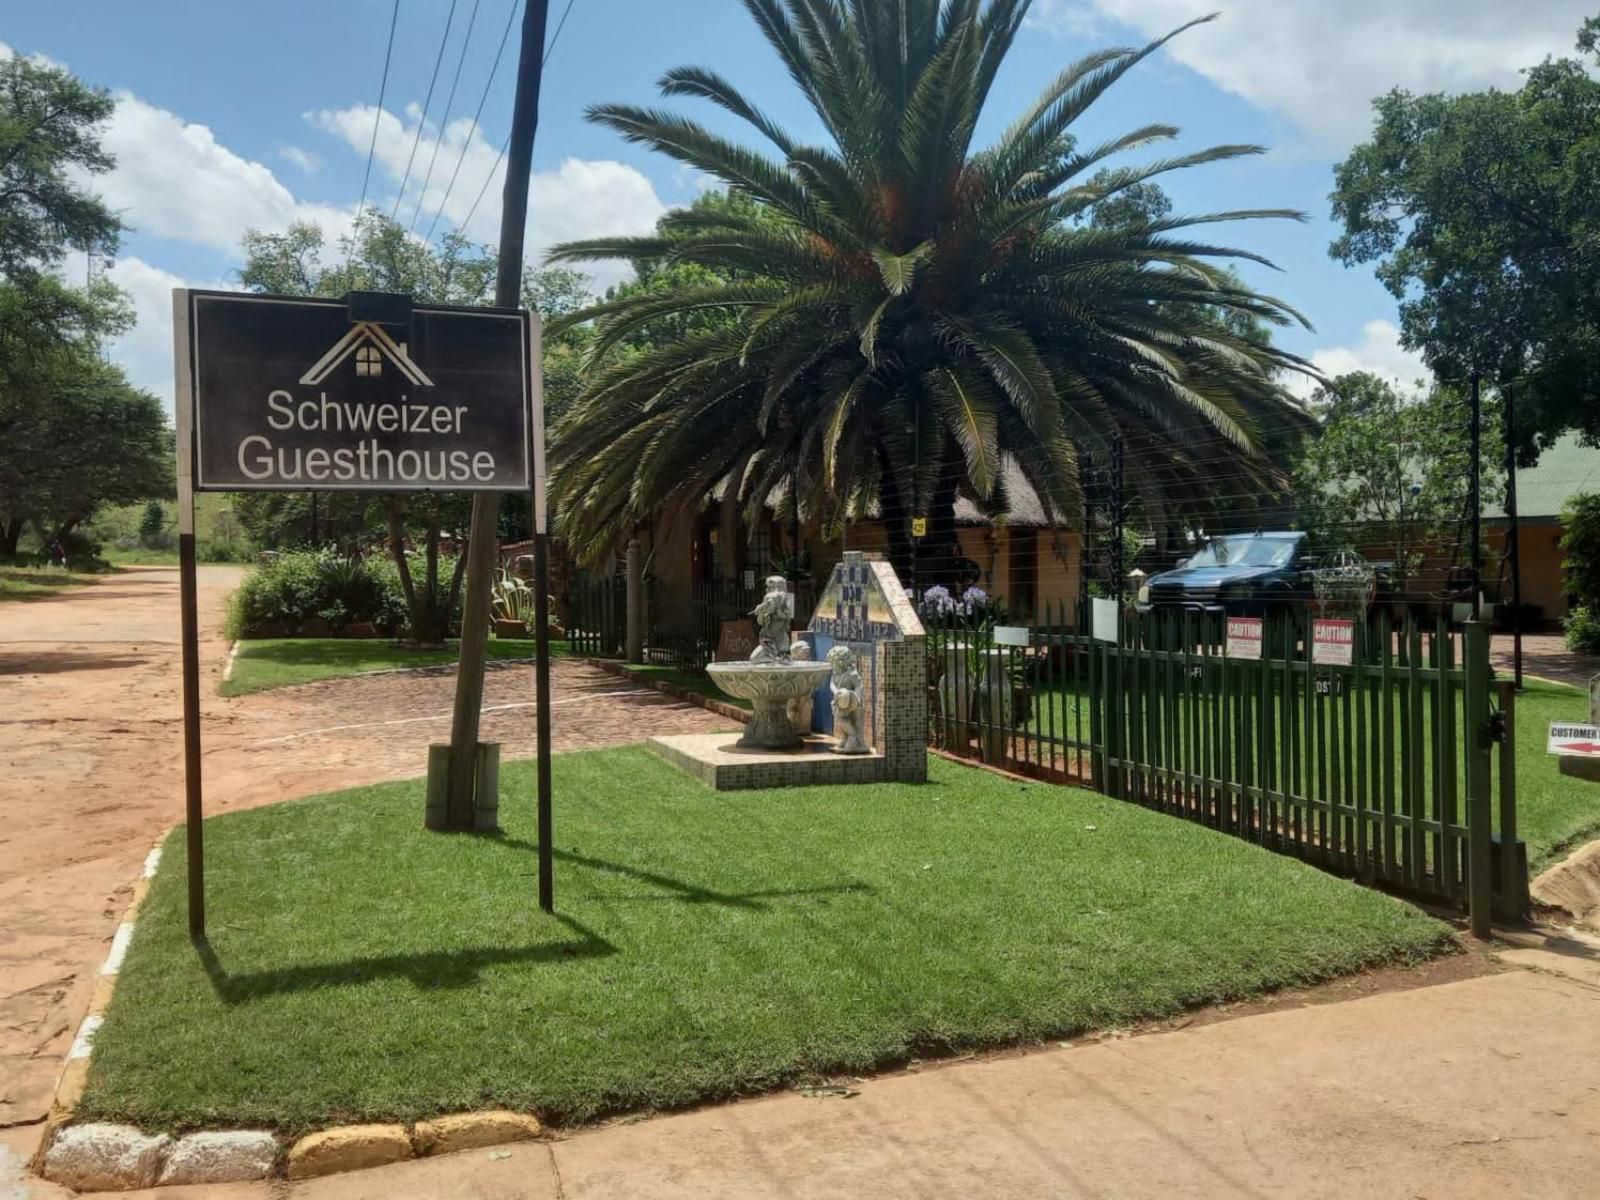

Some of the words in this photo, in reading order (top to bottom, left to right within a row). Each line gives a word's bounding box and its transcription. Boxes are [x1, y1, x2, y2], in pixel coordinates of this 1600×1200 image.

[267, 390, 468, 434] Schweizer
[237, 435, 496, 481] Guesthouse
[1228, 623, 1262, 637] CAUTION
[1315, 625, 1352, 640] CAUTION
[1552, 728, 1597, 739] CUSTOMER
